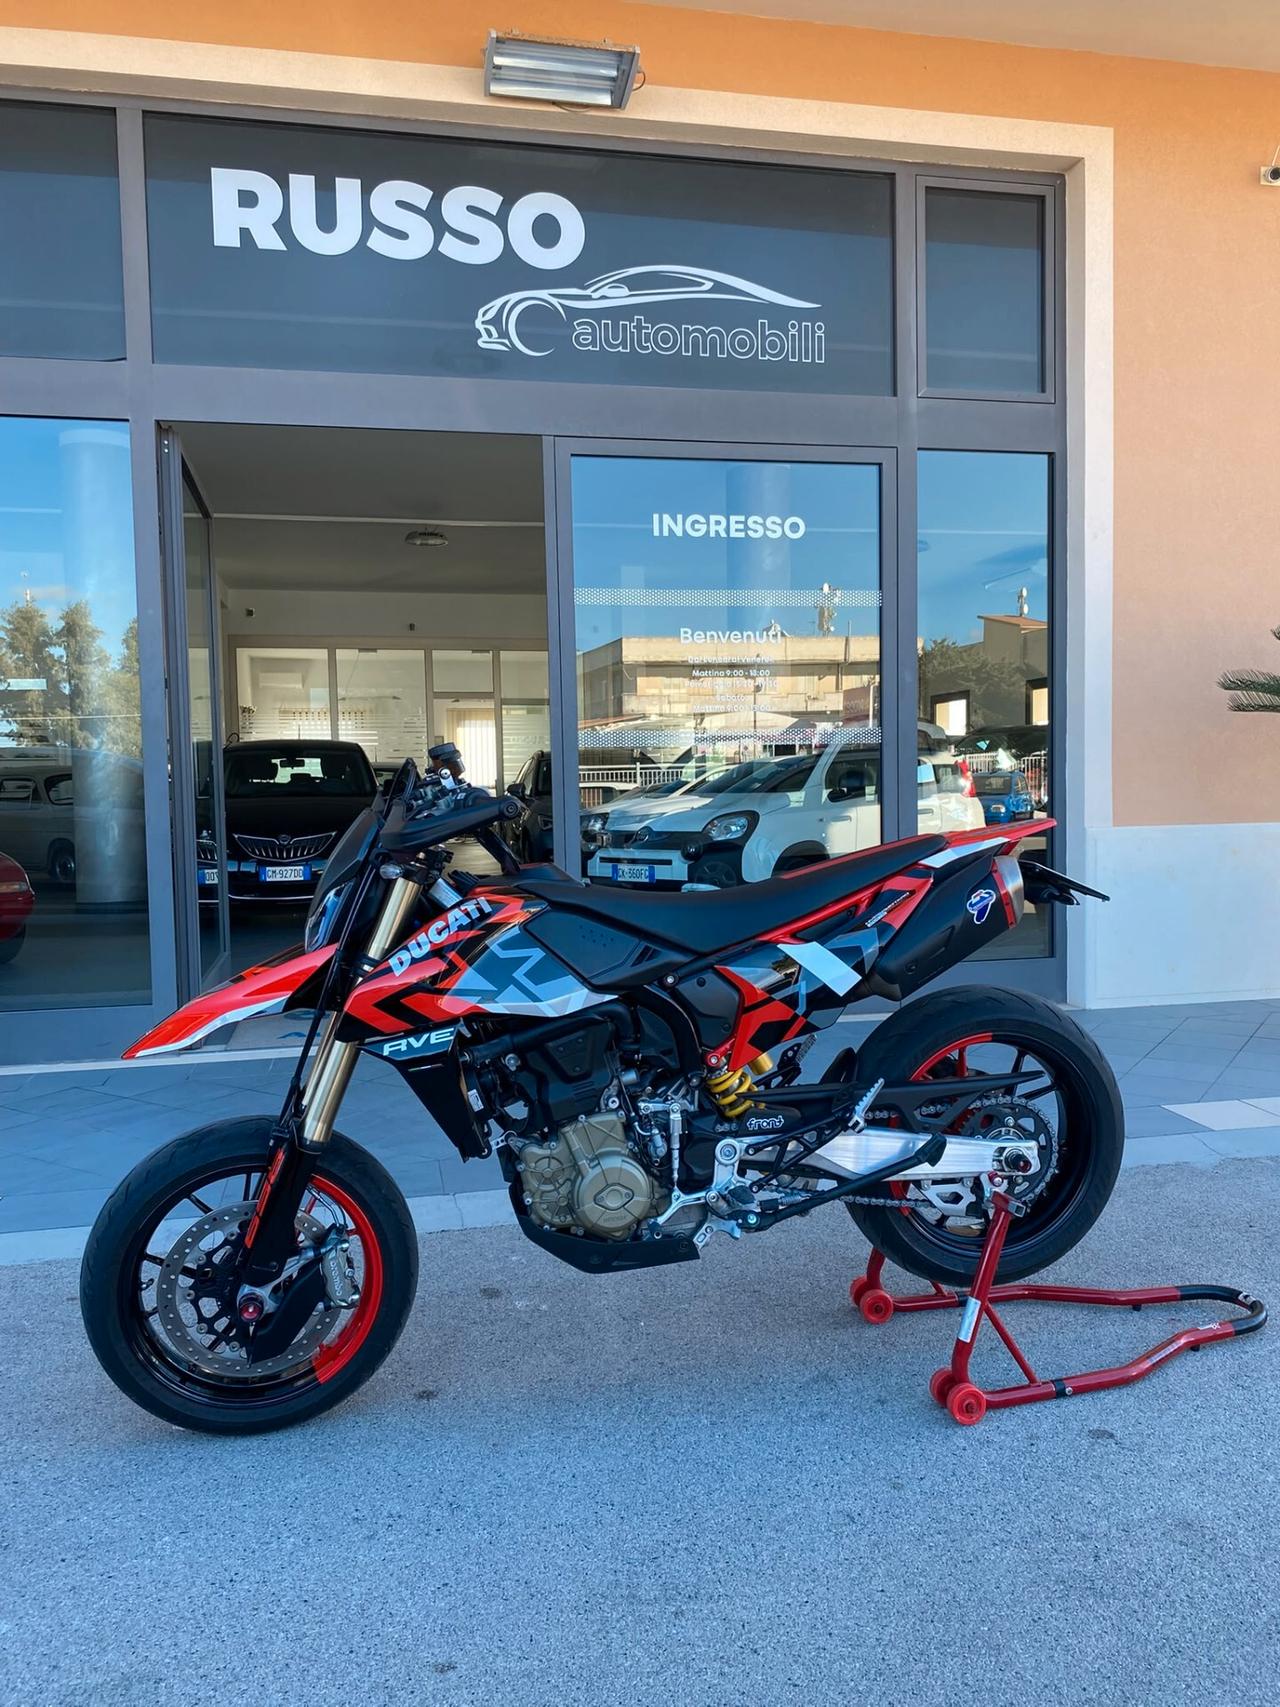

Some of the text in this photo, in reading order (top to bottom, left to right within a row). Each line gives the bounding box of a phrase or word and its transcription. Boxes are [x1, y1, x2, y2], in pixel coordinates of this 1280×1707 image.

[211, 167, 586, 270] RUSSO
[572, 316, 826, 364] automobili
[652, 513, 806, 539] INGRESSO
[680, 627, 782, 644] Benvenuti
[388, 897, 492, 976] DUCATI
[746, 1114, 785, 1131] front
